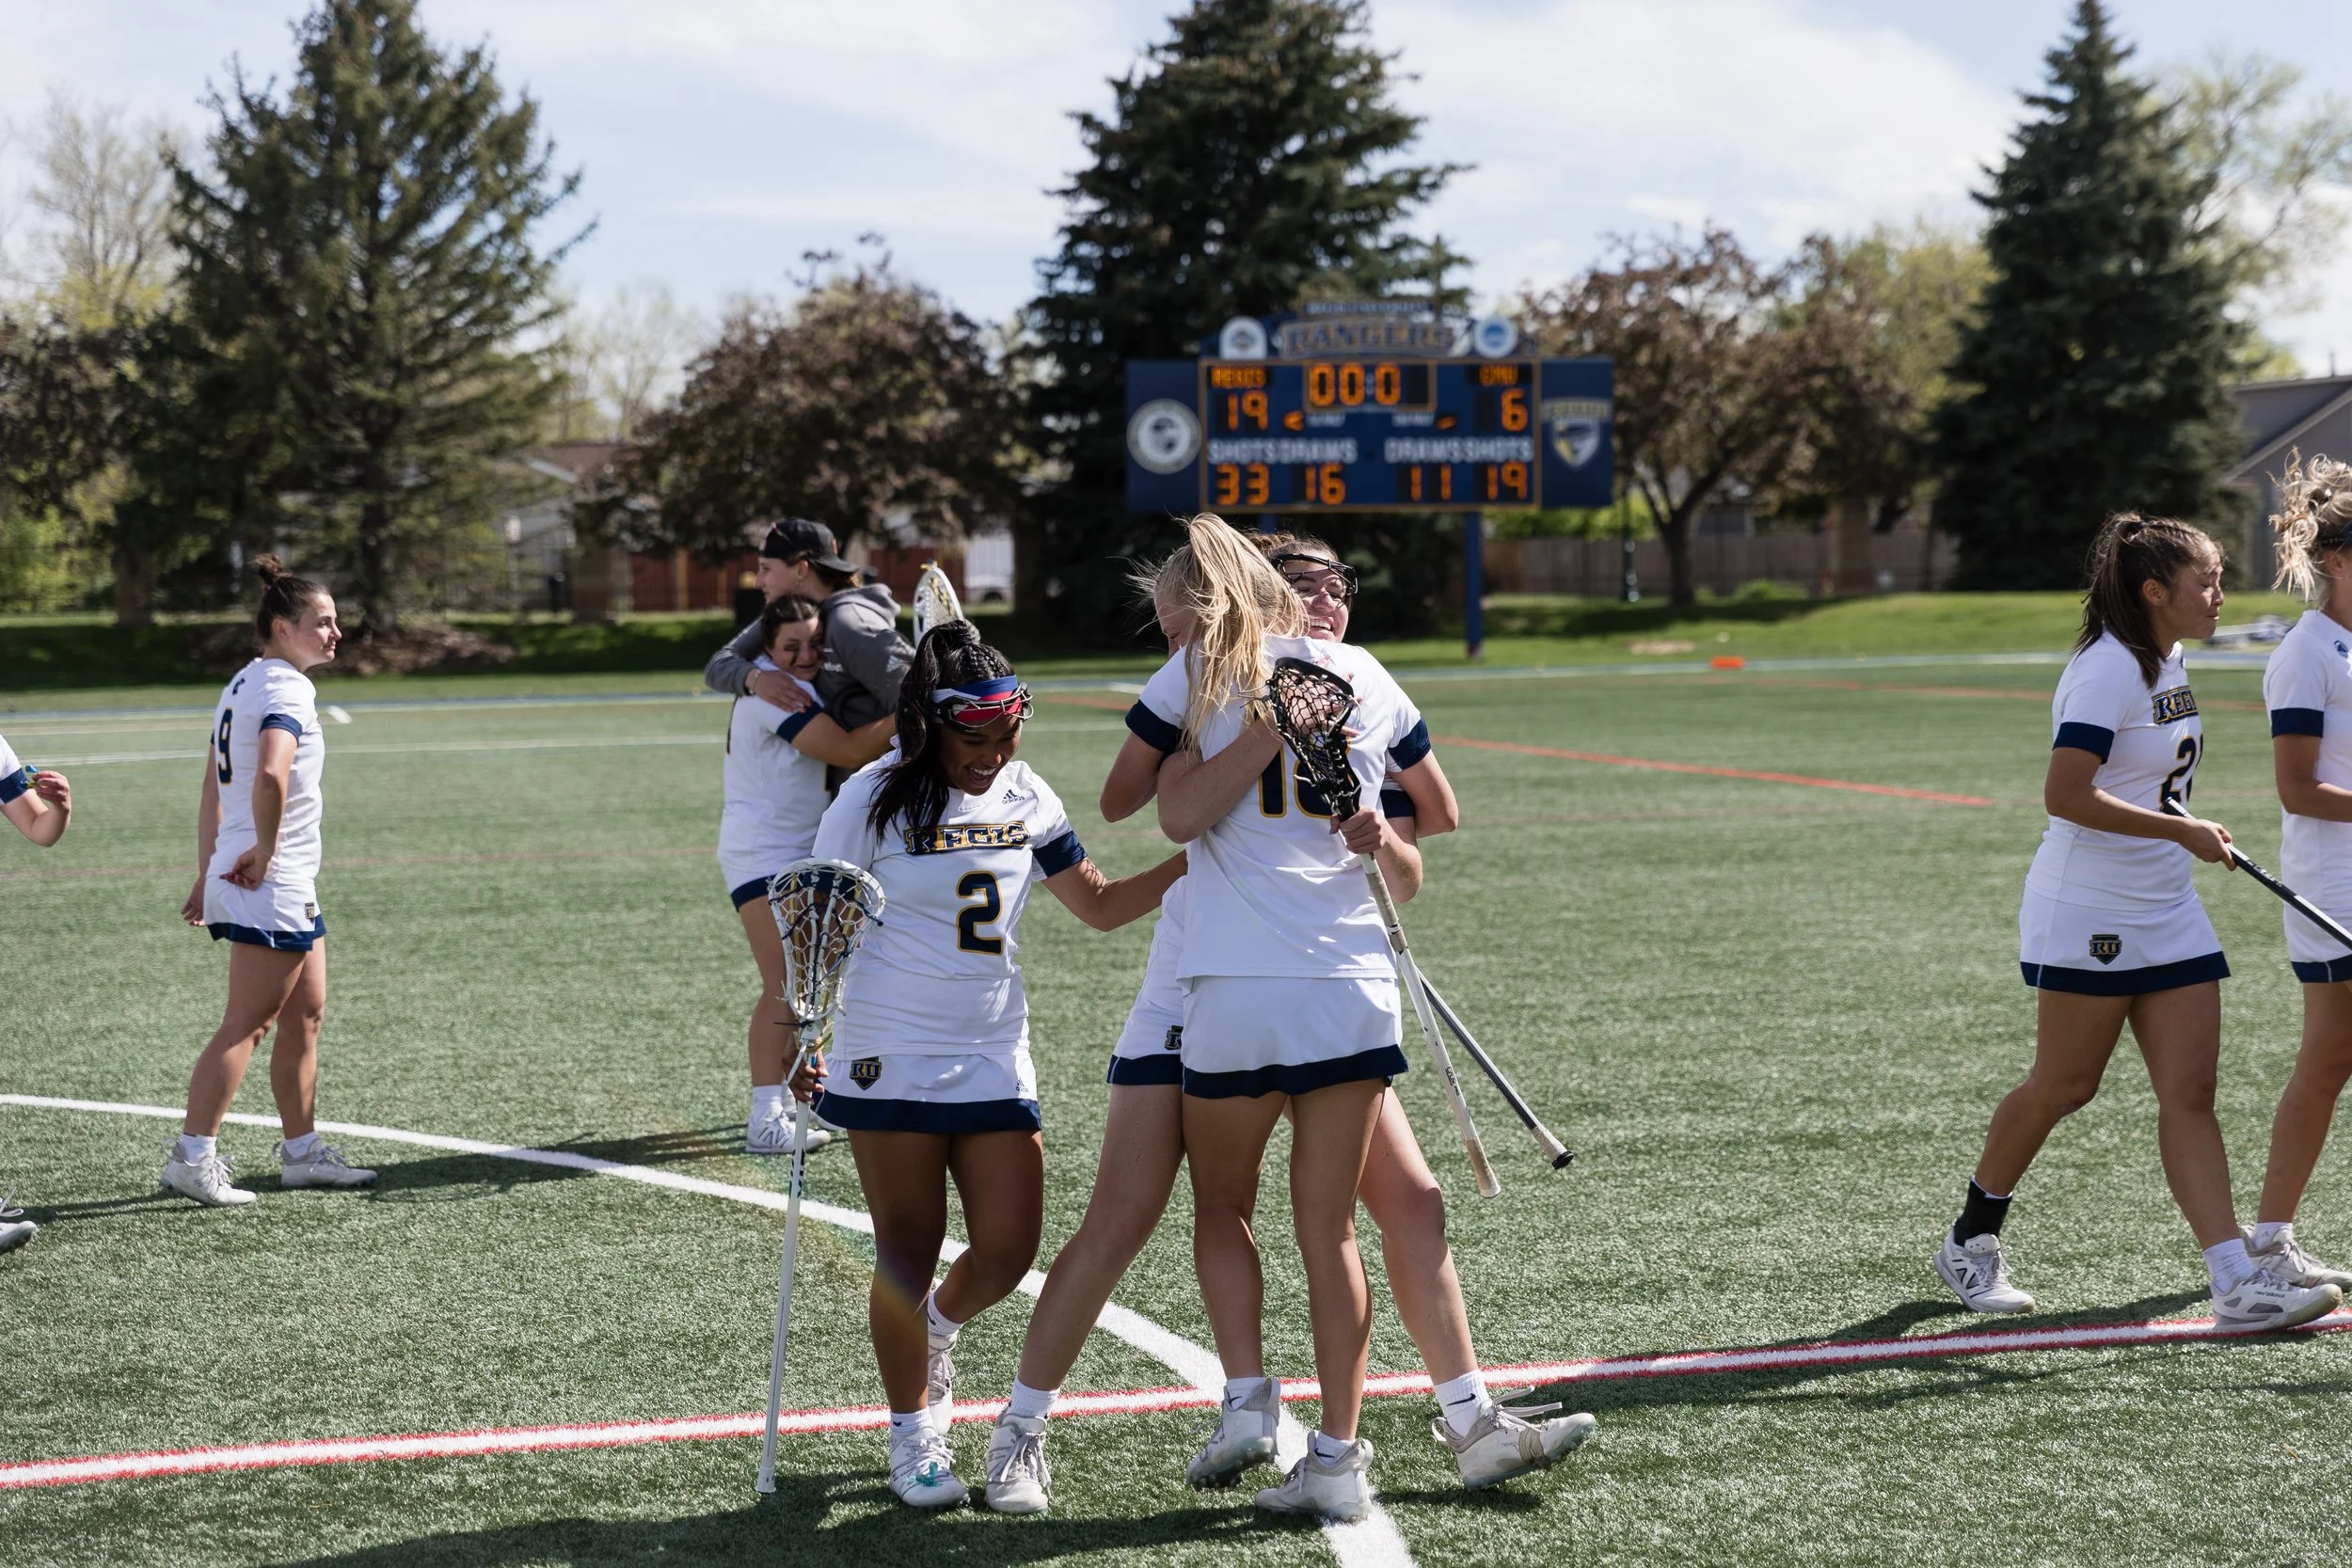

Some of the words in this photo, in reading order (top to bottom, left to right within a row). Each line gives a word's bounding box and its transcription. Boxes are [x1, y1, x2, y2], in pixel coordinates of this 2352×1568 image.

[1228, 390, 1268, 430] 19
[1502, 388, 1528, 431] 6
[1209, 438, 1277, 463] SHOTS
[1279, 438, 1357, 463] DRAWS
[1385, 438, 1461, 463] DRAWS
[1464, 437, 1533, 463] SHOTS
[1216, 463, 1269, 505] 33
[1306, 463, 1345, 505] 16
[1410, 465, 1452, 500] 11
[1487, 460, 1528, 500] 19
[218, 707, 232, 785] 9
[1001, 795, 1025, 804] adidas
[904, 821, 1031, 855] REGIS
[956, 871, 1004, 956] 2
[850, 1060, 882, 1081] RU
